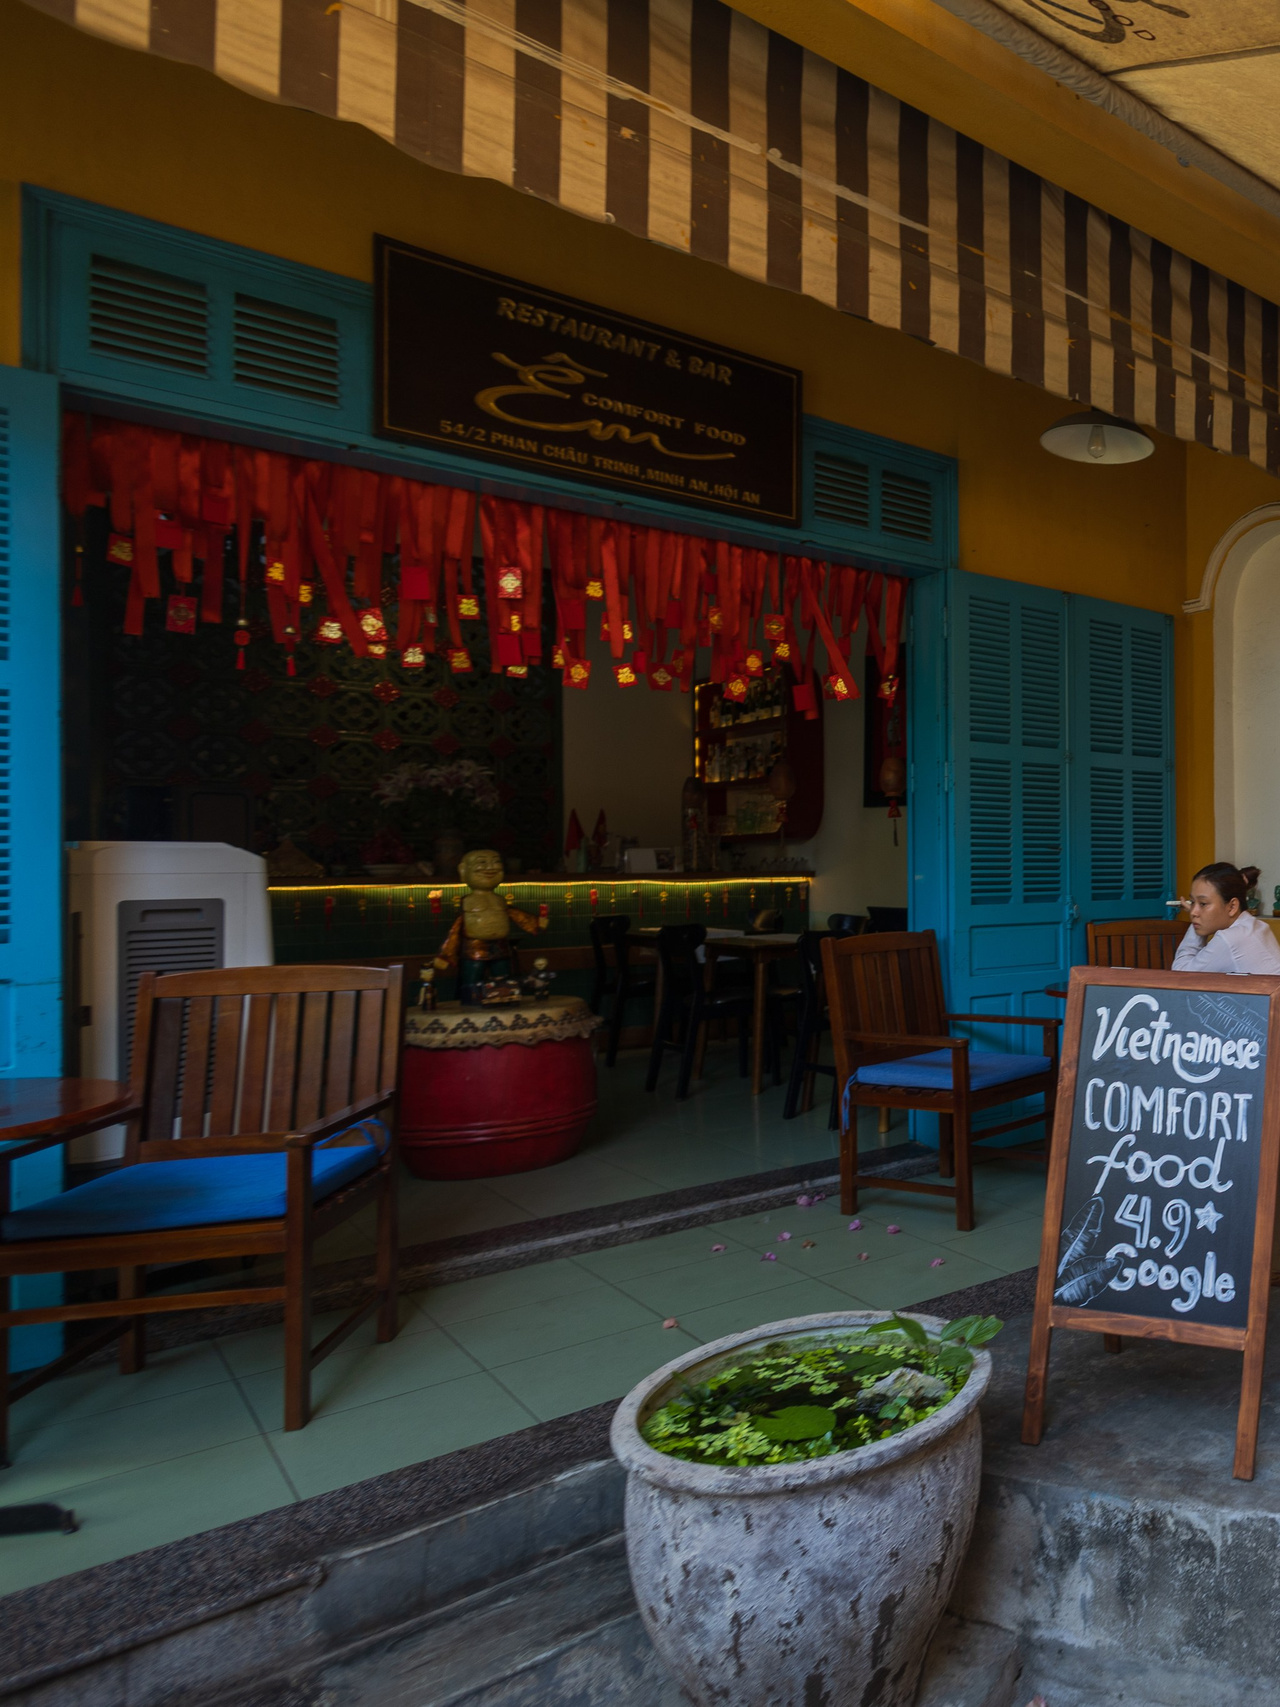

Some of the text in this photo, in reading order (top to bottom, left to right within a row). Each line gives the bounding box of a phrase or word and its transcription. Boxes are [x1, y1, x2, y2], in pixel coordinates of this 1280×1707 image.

[496, 297, 732, 385] RESTAURANT & BAR
[582, 392, 747, 446] COMFORT FOOD
[440, 420, 486, 442] 54/2
[490, 431, 538, 453] PHAN
[542, 443, 588, 465] CHÂU
[742, 490, 760, 504] AN
[1091, 993, 1261, 1084] Vietnamese
[1084, 1077, 1253, 1142] COMFORT
[1086, 1133, 1234, 1197] food
[1105, 1242, 1236, 1313] Google
